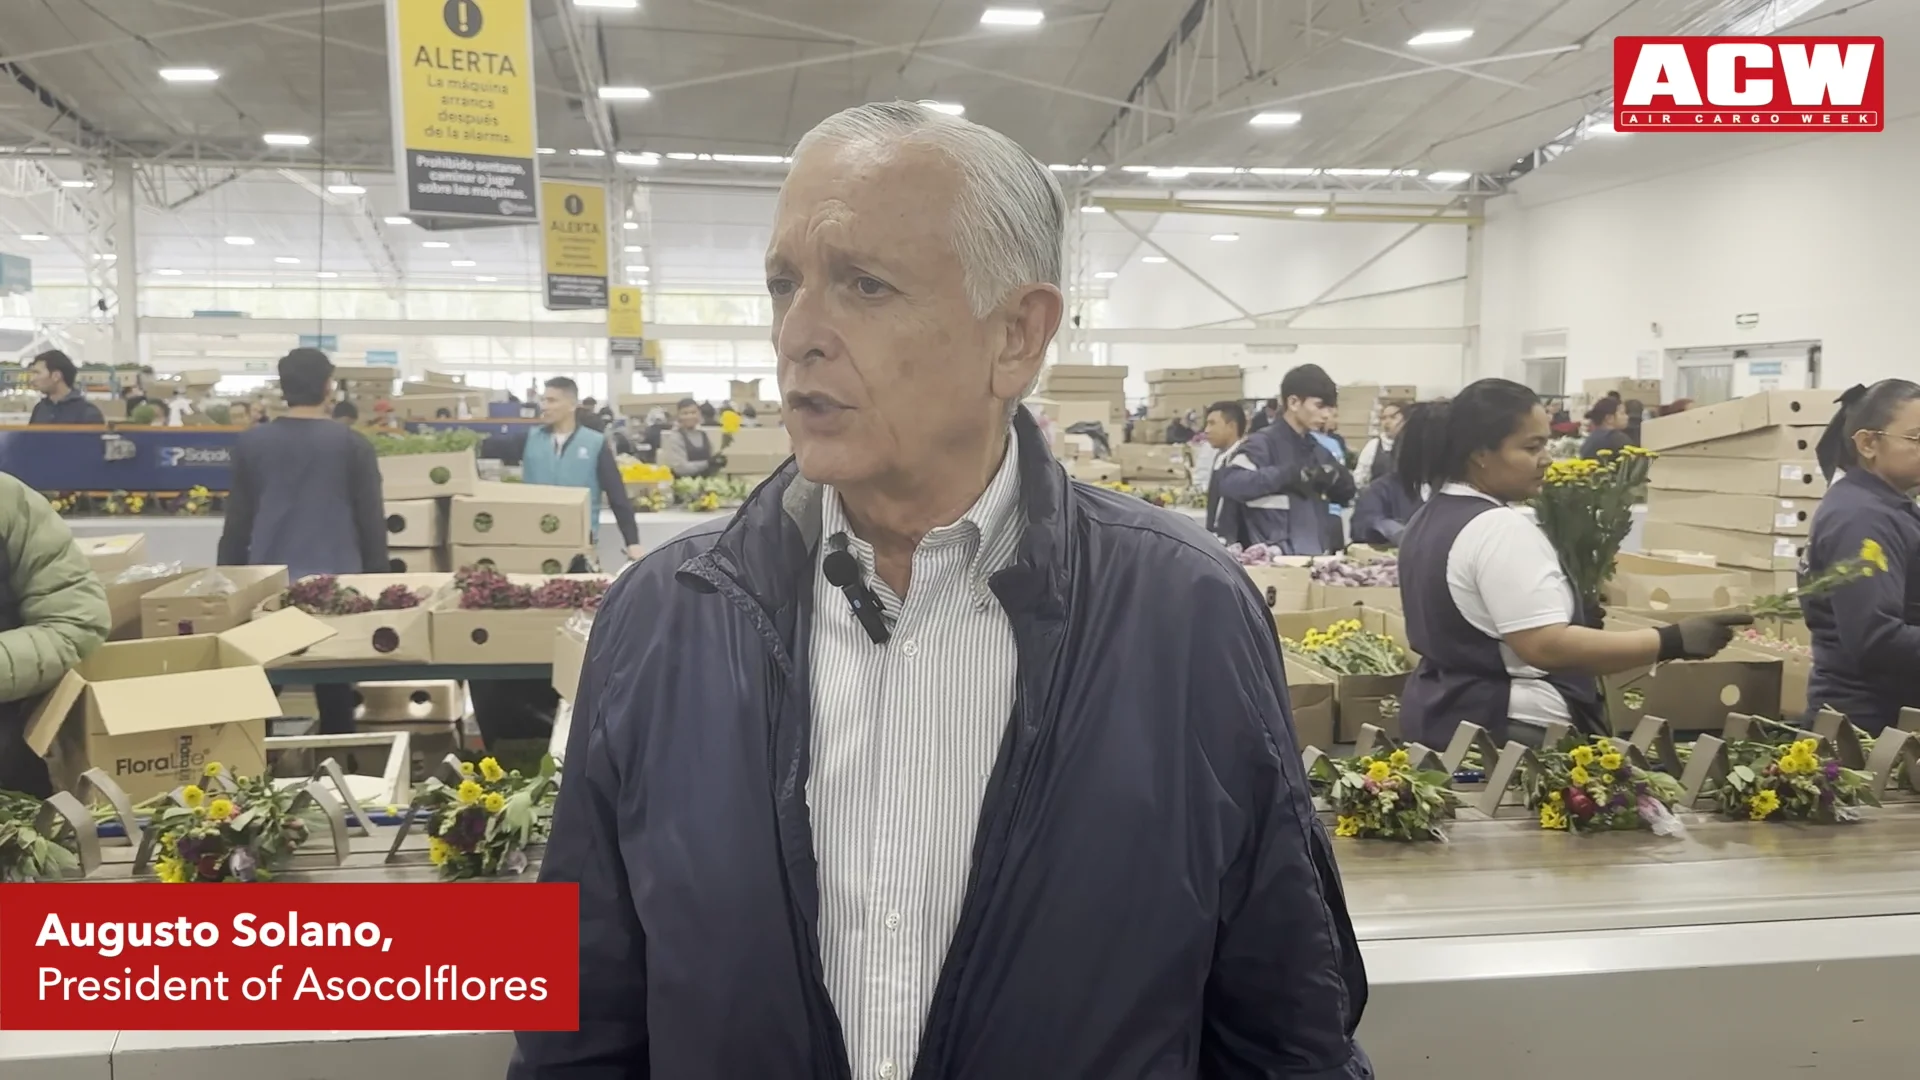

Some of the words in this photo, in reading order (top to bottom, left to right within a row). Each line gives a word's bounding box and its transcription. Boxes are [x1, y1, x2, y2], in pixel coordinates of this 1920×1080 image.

[414, 45, 516, 77] ALERTA
[427, 75, 443, 88] La
[447, 78, 509, 94] máquina
[441, 95, 495, 109] arranca
[438, 110, 499, 126] después
[424, 125, 442, 138] de
[447, 126, 458, 139] la
[416, 154, 474, 170] Prohibido
[428, 170, 476, 184] caminar
[476, 174, 485, 184] o
[486, 173, 515, 188] jugar
[417, 183, 452, 195] sobre
[453, 184, 470, 196] las
[551, 221, 600, 234] ALERTA
